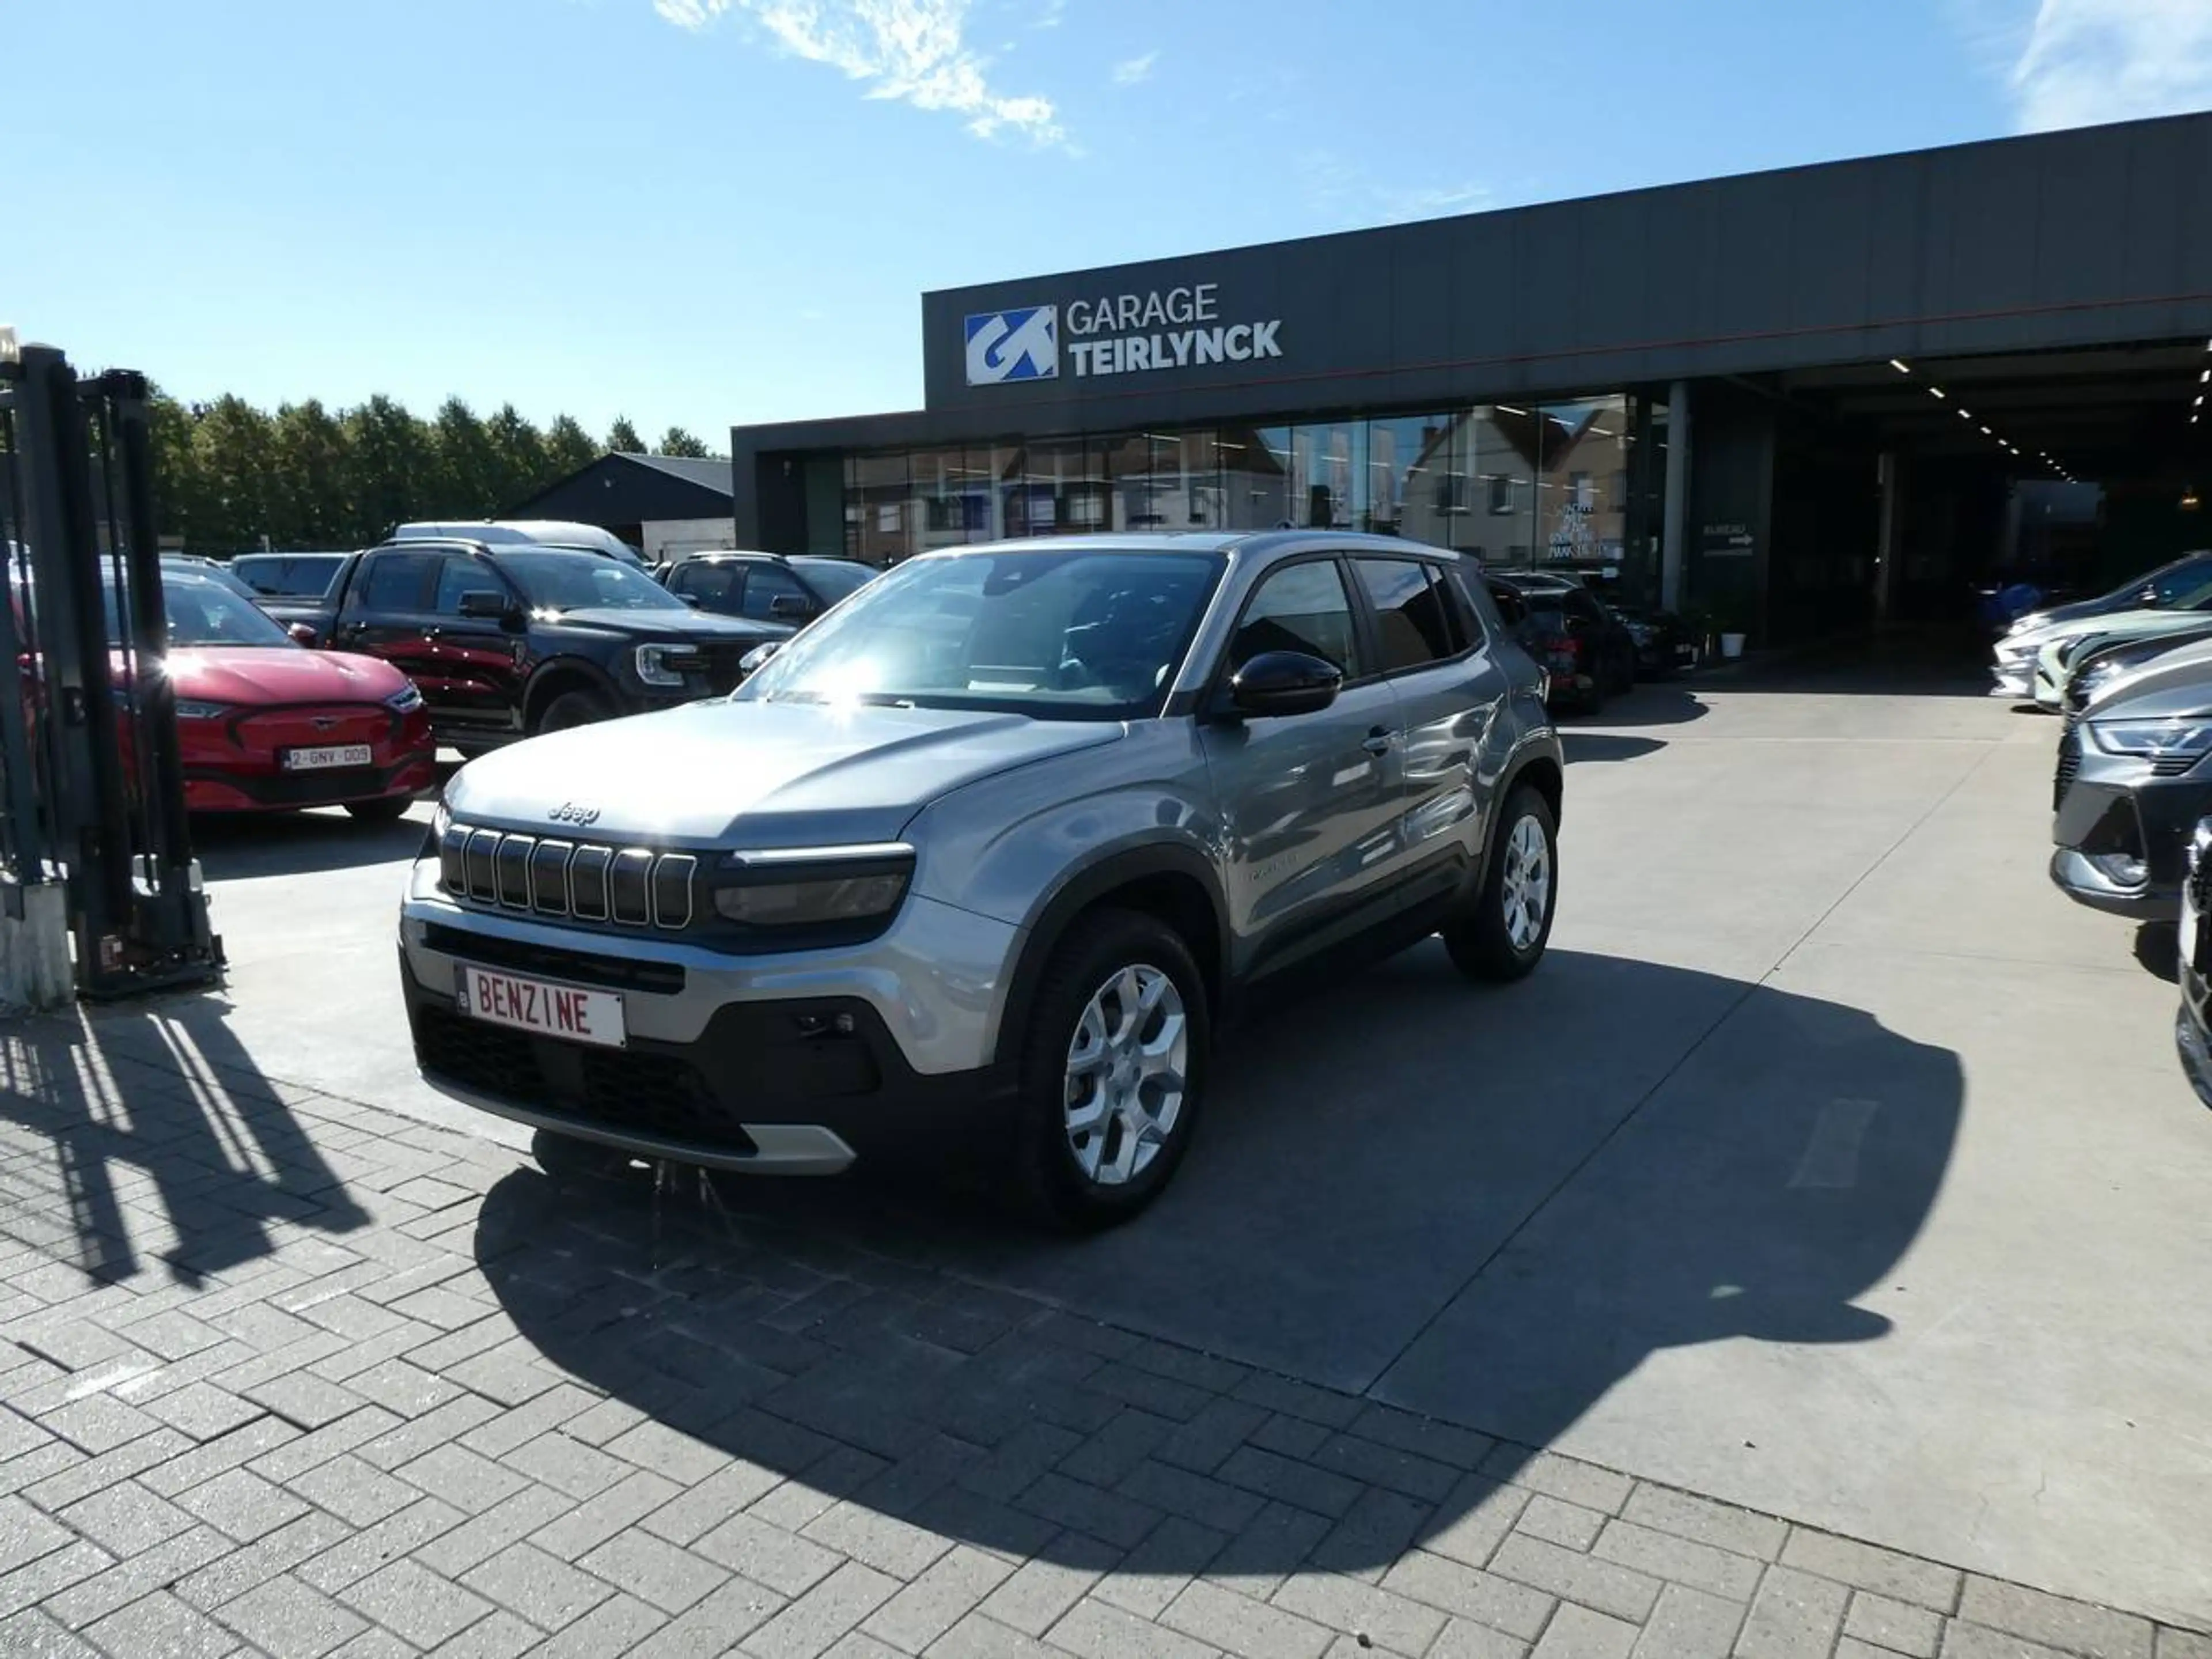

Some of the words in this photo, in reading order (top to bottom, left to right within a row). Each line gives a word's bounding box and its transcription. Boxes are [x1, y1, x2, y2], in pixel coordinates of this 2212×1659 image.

[1066, 283, 1218, 335] GARAGE
[1069, 320, 1282, 377] TEIRLYNCK
[547, 801, 600, 827] Jeep
[477, 974, 592, 1035] BENZINE
